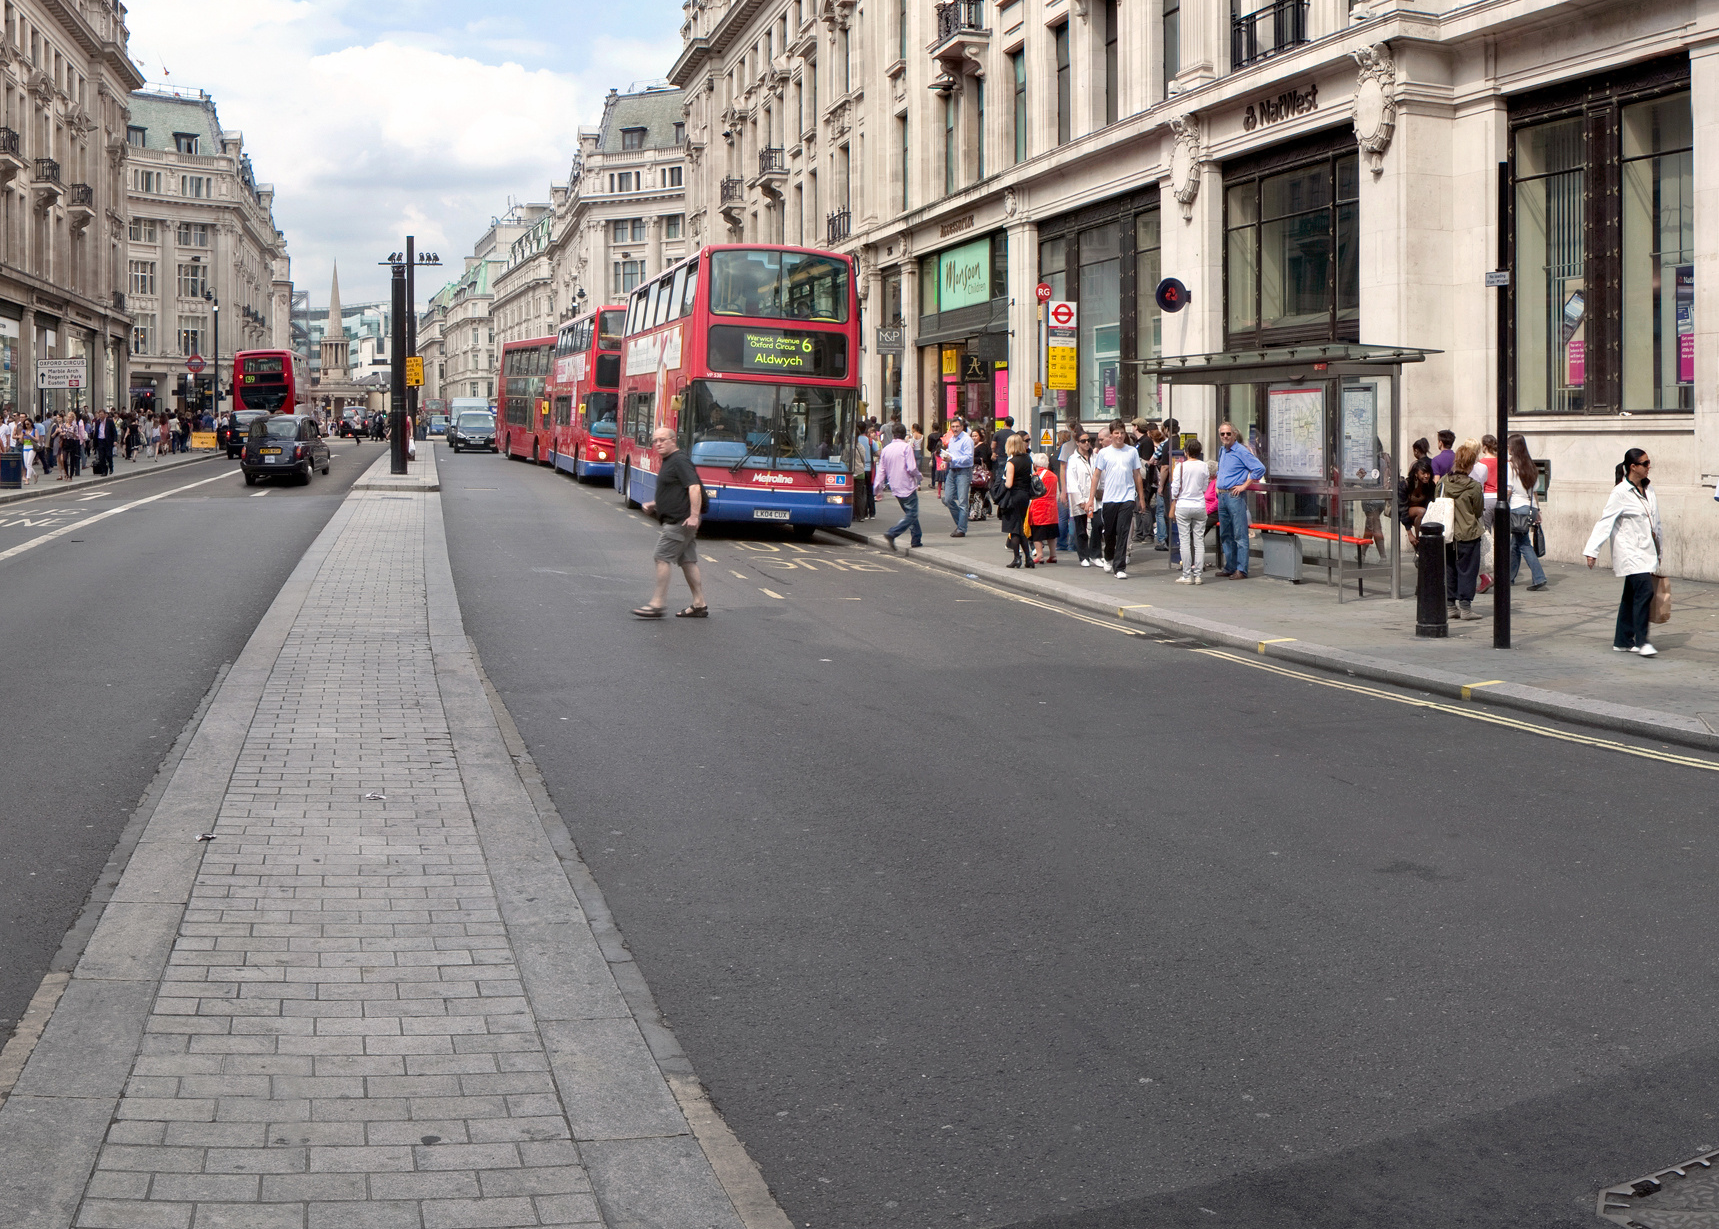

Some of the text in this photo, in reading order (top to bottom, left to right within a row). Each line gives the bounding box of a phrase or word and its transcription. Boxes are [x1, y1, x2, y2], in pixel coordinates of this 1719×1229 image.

[1258, 83, 1319, 127] NatWest
[945, 259, 981, 294] Monsoon
[967, 281, 986, 295] Children
[1037, 288, 1050, 296] RG
[746, 333, 800, 345] Warwick Avenue
[879, 331, 900, 342] M&P
[750, 340, 796, 351] Oxford Circus
[801, 338, 813, 353] 6
[754, 352, 803, 368] Aldwych
[244, 375, 256, 383] 139
[752, 472, 794, 485] Metroline
[755, 510, 788, 519] LK04 CUX
